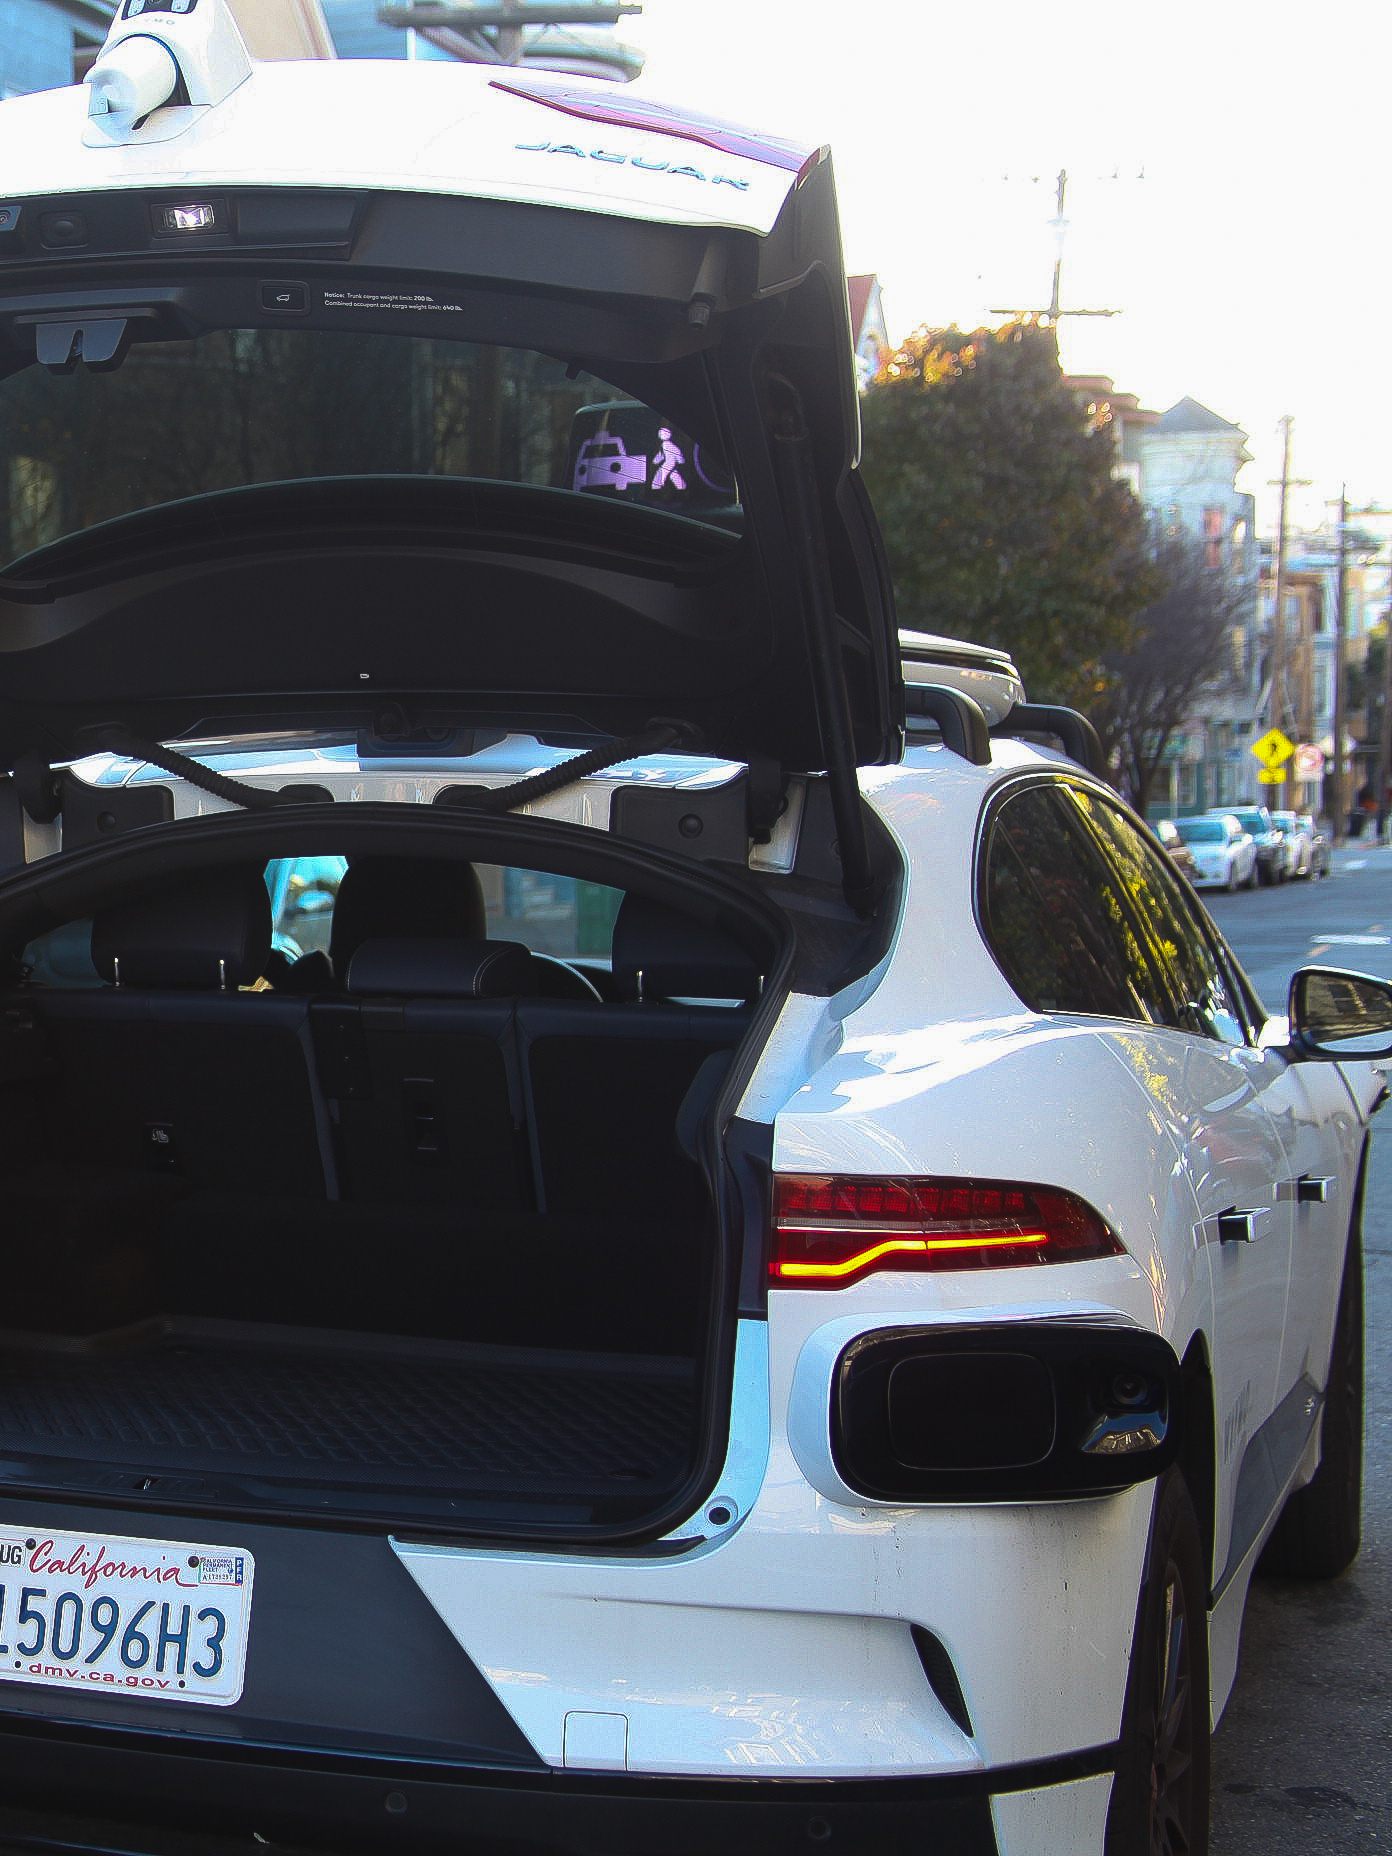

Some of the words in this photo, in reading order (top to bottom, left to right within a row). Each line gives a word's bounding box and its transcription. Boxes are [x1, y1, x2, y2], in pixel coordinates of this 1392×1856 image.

[514, 142, 750, 191] JAGUAR
[380, 294, 398, 302] weight
[408, 303, 427, 311] weight
[29, 1539, 199, 1589] California
[28, 1663, 171, 1689] dmv.ca.gov
